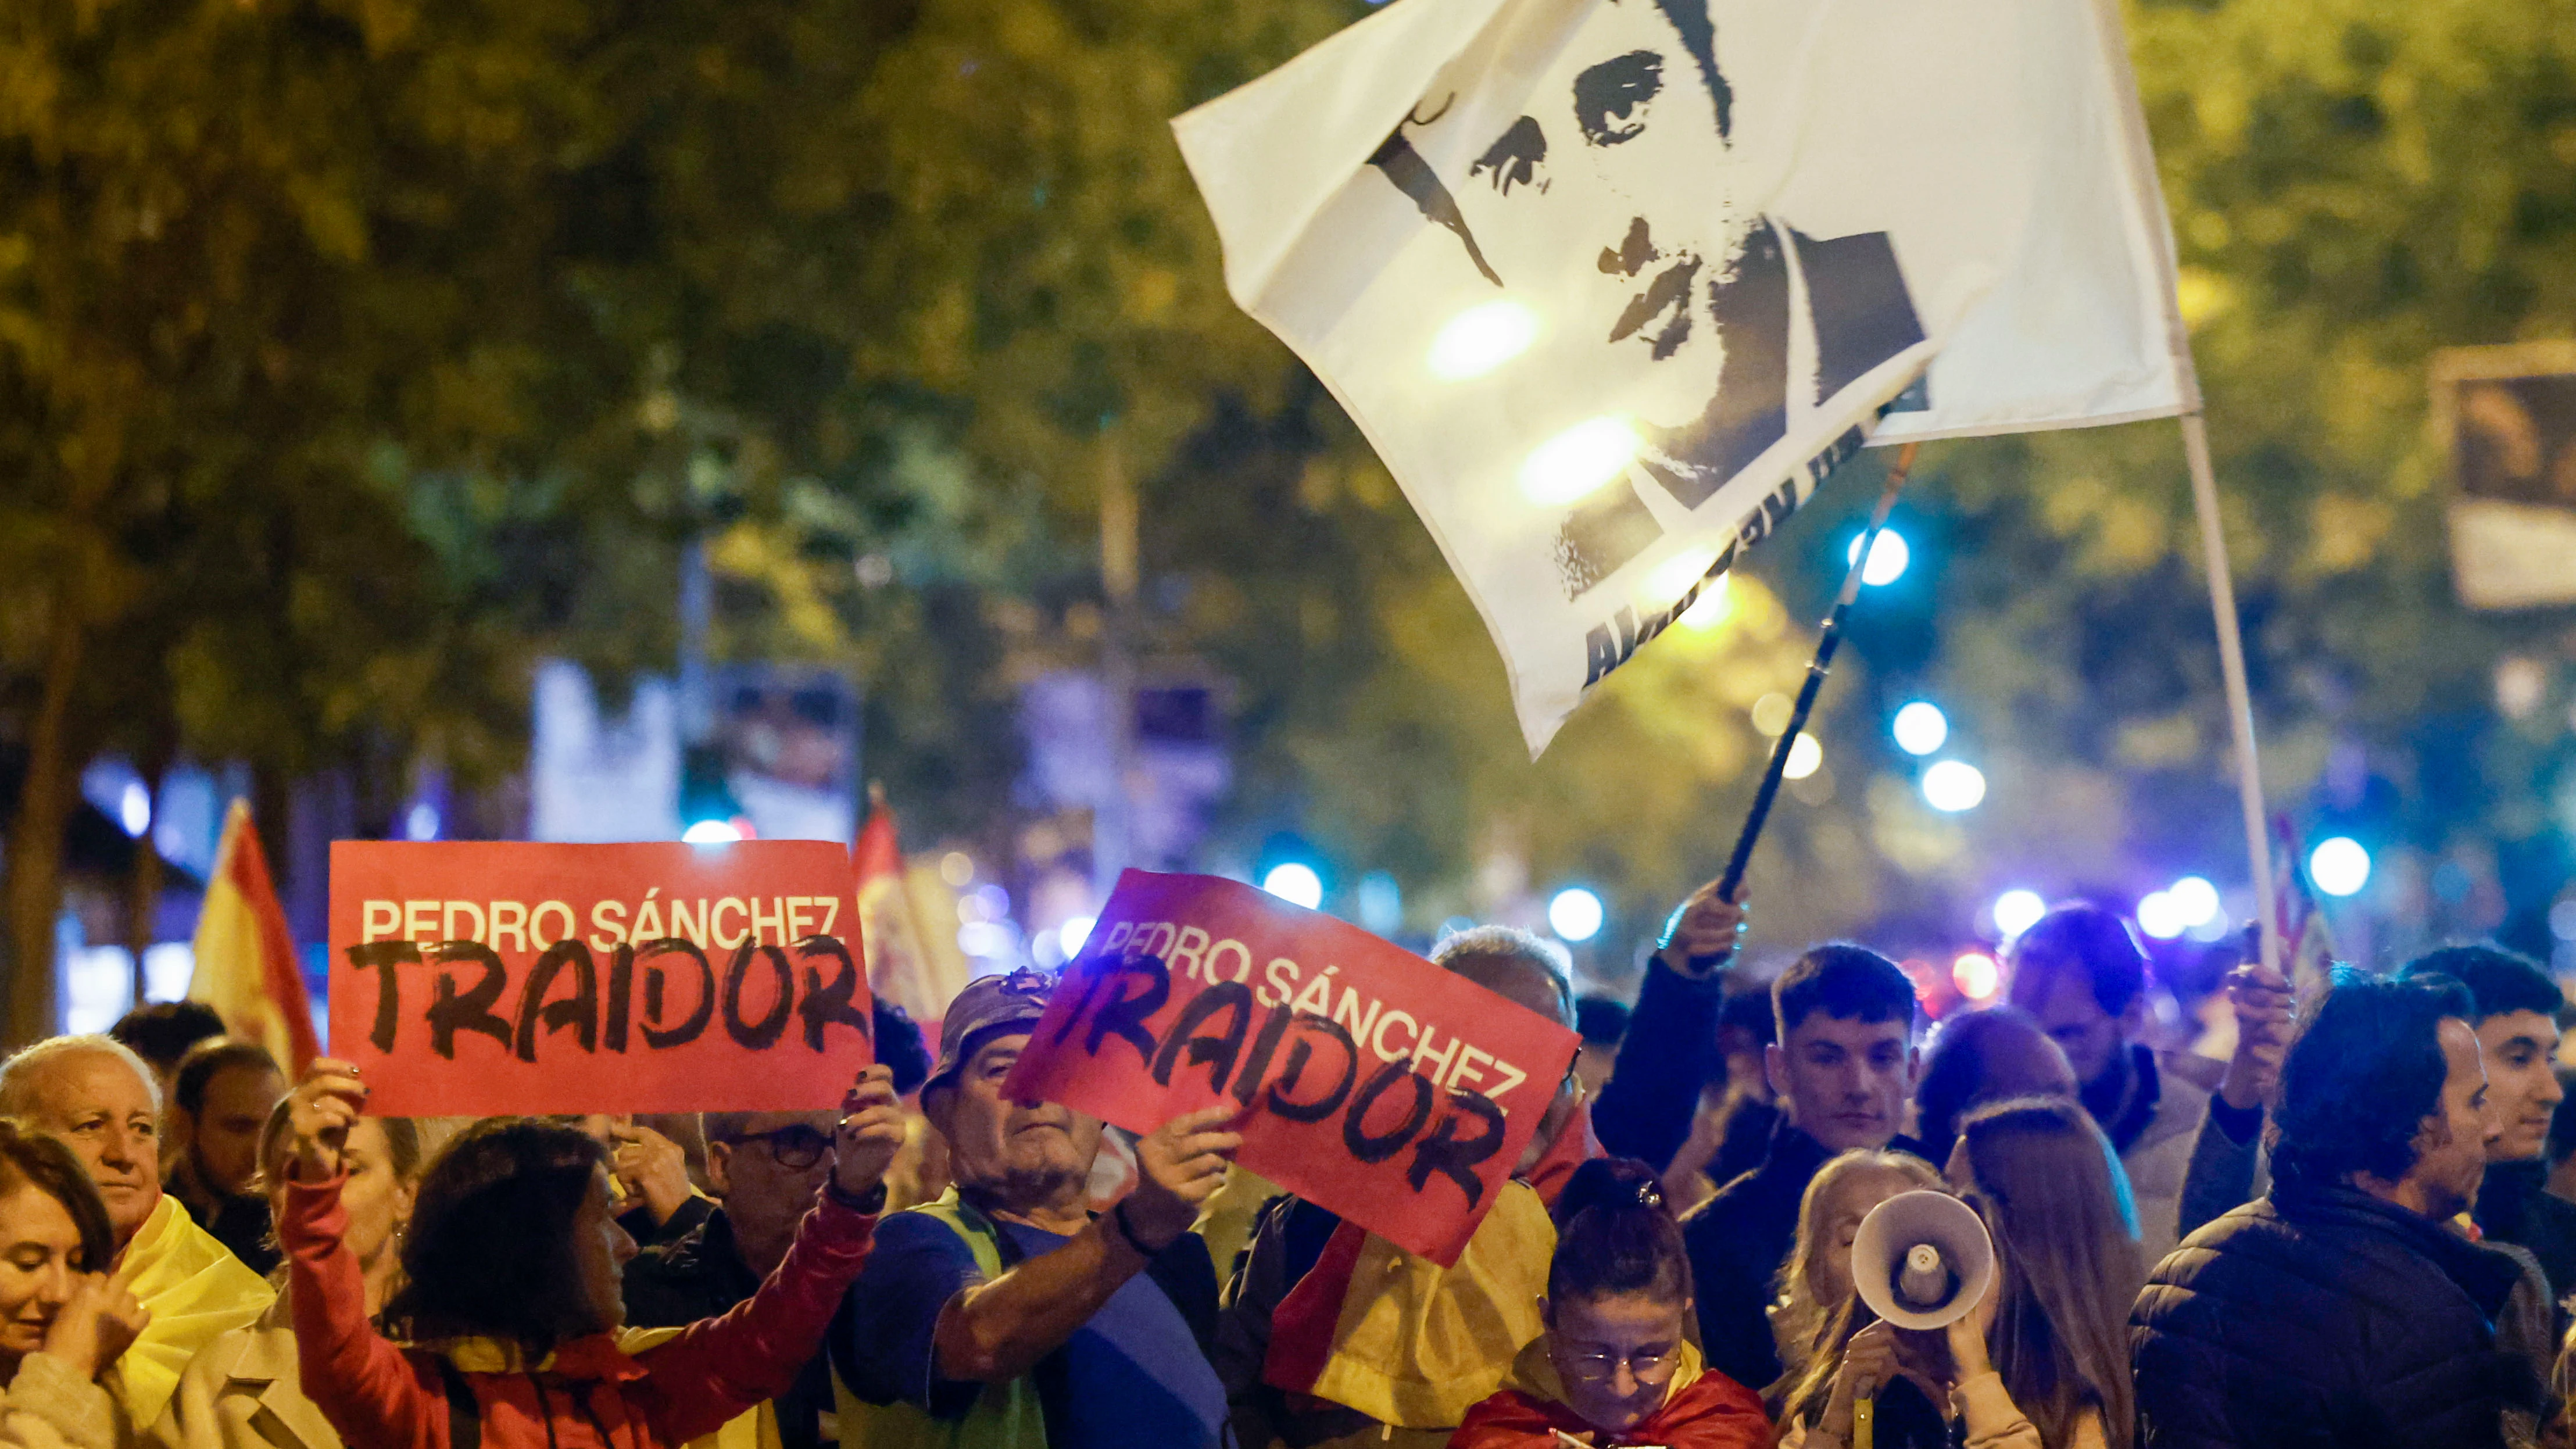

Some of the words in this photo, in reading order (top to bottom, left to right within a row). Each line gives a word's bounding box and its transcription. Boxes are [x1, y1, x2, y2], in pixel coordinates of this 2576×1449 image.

[344, 934, 871, 1063] TRAIDOR
[362, 899, 577, 953] PEDRO
[589, 887, 845, 953] SÁNCHEZ
[1054, 952, 1506, 1214] TRAIDOR
[1101, 921, 1251, 986] PEDRO
[1256, 965, 1527, 1117] SÁNCHEZ
